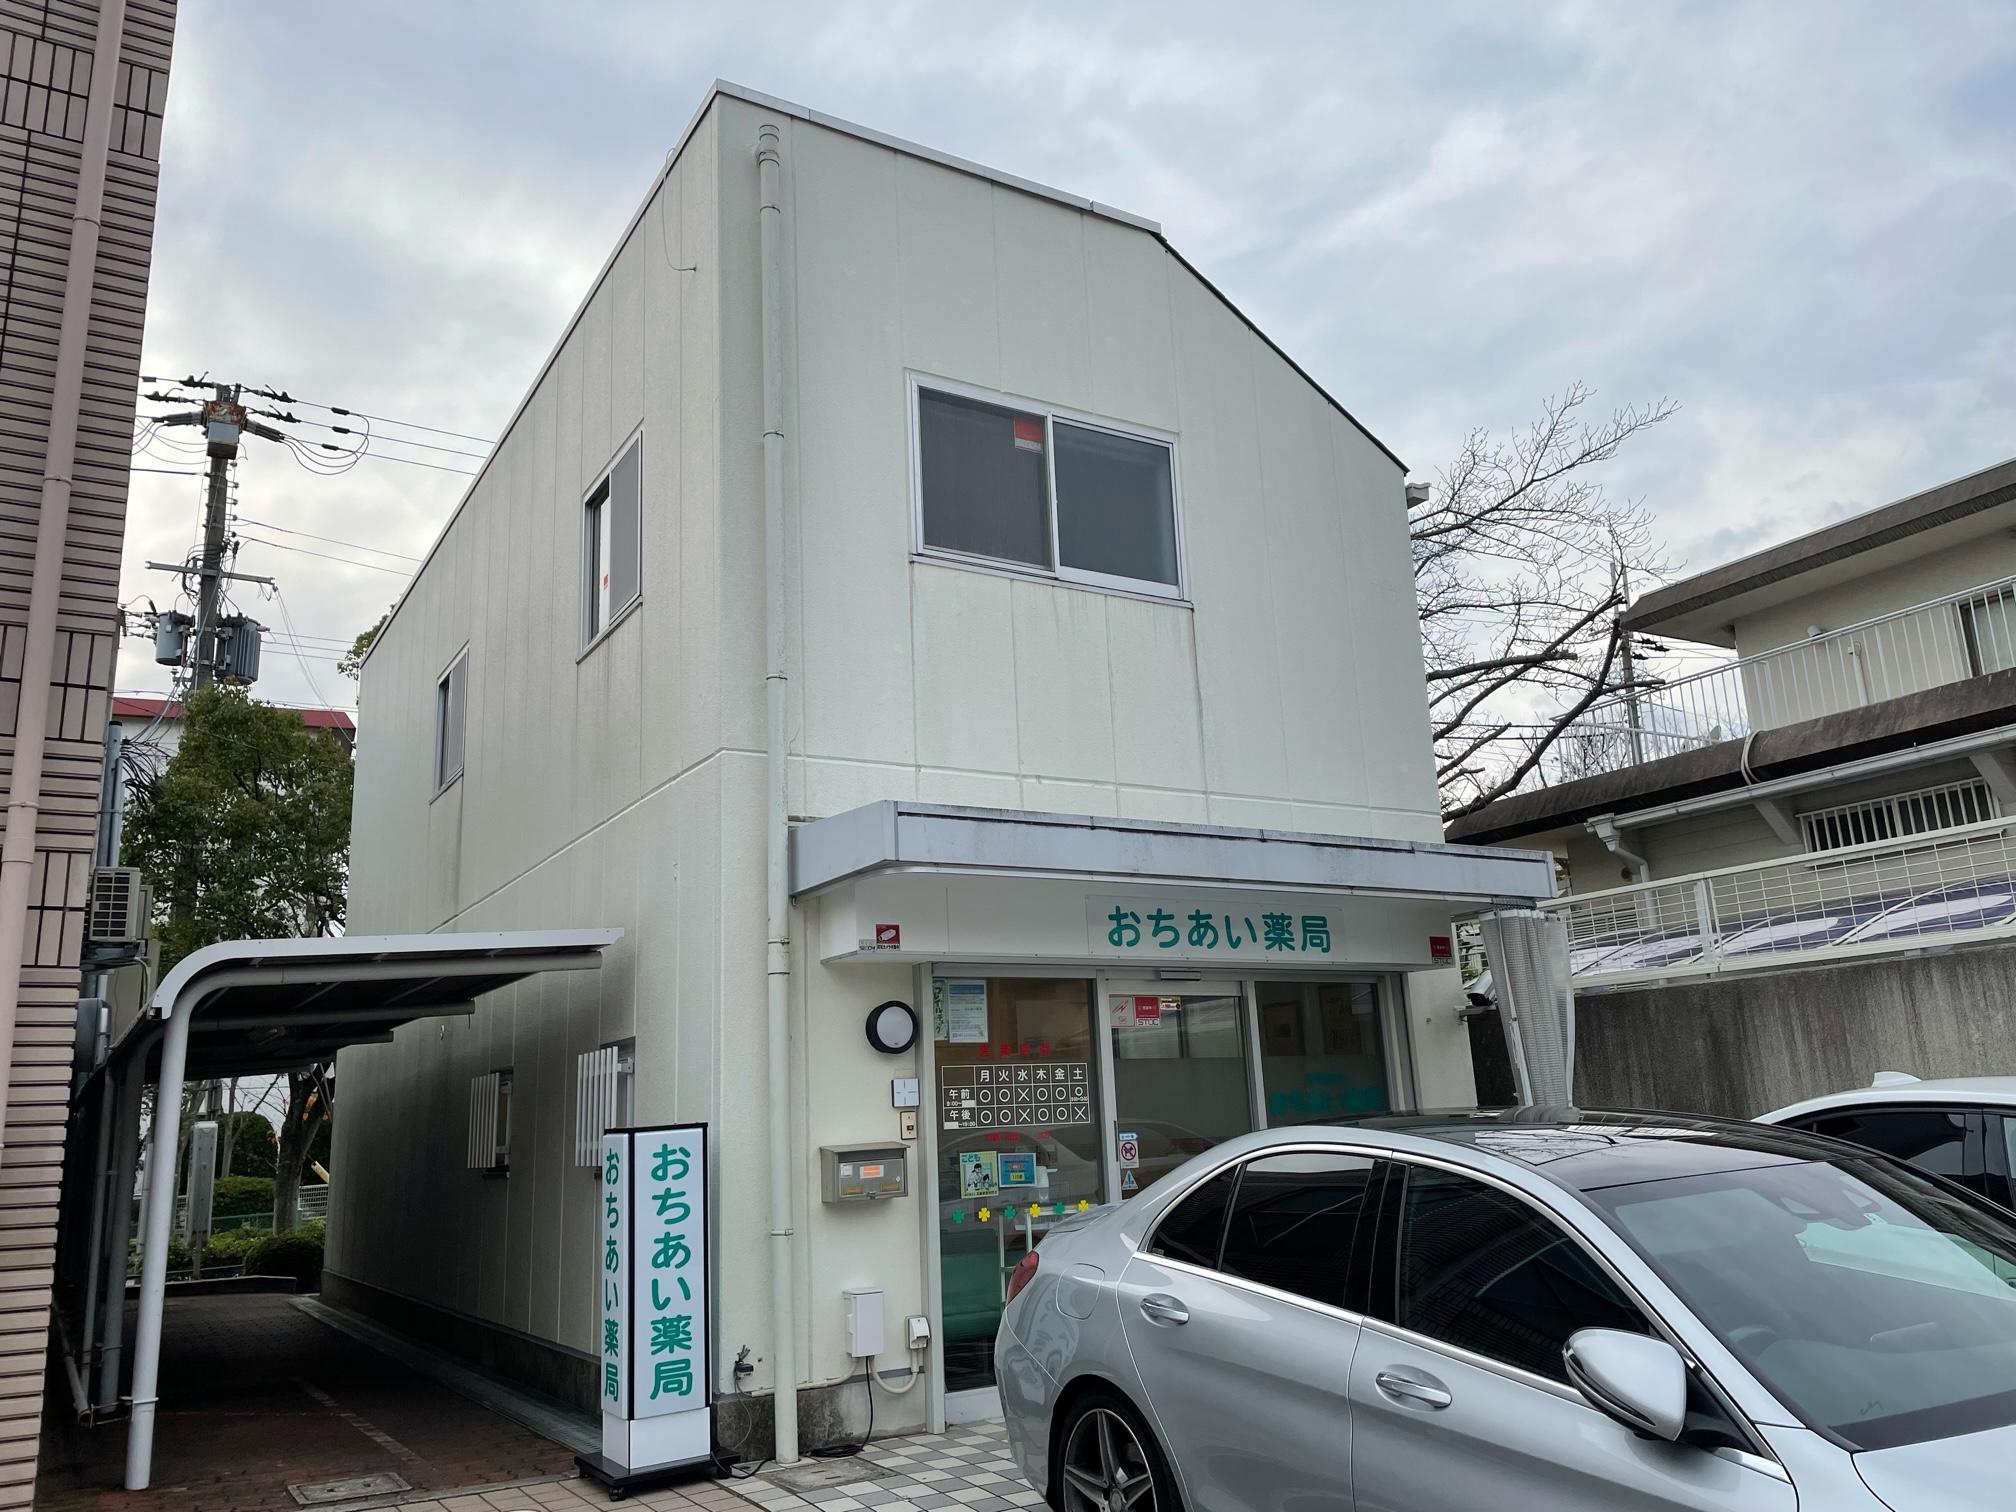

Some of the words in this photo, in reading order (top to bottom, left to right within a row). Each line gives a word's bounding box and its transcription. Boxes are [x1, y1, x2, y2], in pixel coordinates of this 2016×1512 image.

[1107, 905, 1331, 953] おちあい薬局
[979, 1070, 990, 1082] 月
[998, 1069, 1010, 1082] 火
[1017, 1069, 1029, 1081] 水
[1036, 1068, 1048, 1081] 木
[1054, 1067, 1066, 1080] 金
[1072, 1067, 1084, 1080] 土
[949, 1088, 971, 1100] 午前
[949, 1110, 971, 1121] 午後
[604, 1148, 620, 1402] おちあい薬局
[650, 1143, 693, 1400] おちあい薬局
